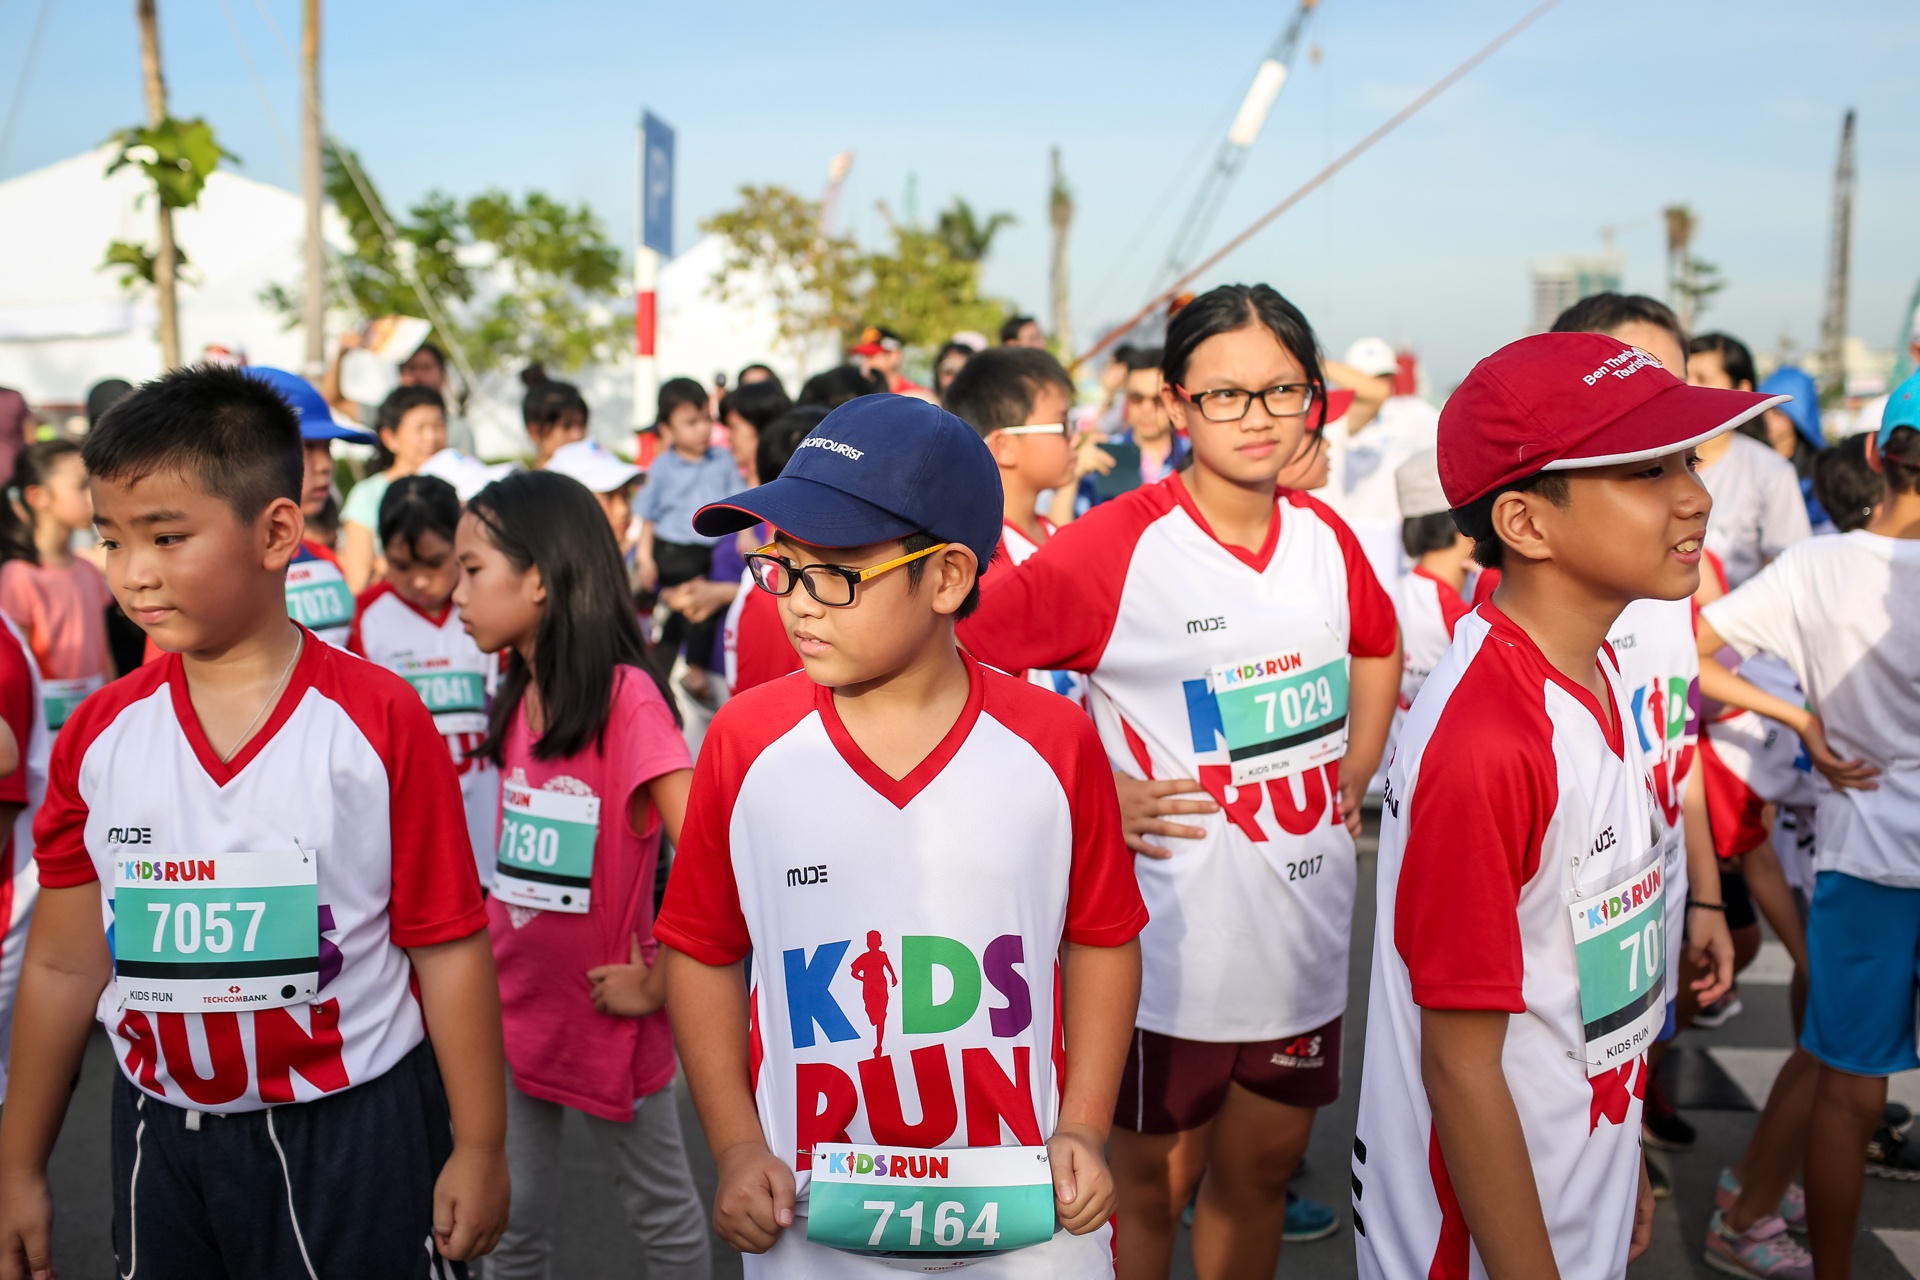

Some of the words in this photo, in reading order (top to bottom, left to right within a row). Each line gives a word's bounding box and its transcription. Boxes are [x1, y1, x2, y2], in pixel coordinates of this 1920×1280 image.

[1582, 366, 1610, 386] Ben
[1604, 349, 1635, 368] Thanh
[286, 586, 343, 621] 7073
[1266, 653, 1302, 676] RUN
[414, 676, 473, 706] 7041
[1254, 676, 1333, 734] 7029
[1248, 764, 1269, 776] KIDS
[1271, 760, 1290, 772] RUN
[125, 859, 163, 883] KIDS
[165, 859, 216, 882] RUN
[1287, 855, 1324, 881] 2017
[1587, 890, 1632, 930] KIDS
[1632, 865, 1661, 908] RUN
[147, 902, 266, 954] 7057
[129, 990, 150, 1002] KIDS
[152, 991, 173, 1003] RUN
[202, 994, 268, 1004] TECHCOMBANK
[117, 997, 350, 1105] RUN
[1606, 1039, 1632, 1059] KIDS
[1633, 1025, 1649, 1045] RUN
[796, 1043, 1045, 1172] RUN
[829, 1151, 887, 1178] KIDS
[889, 1155, 949, 1179] RUN
[863, 1200, 1000, 1247] 7164
